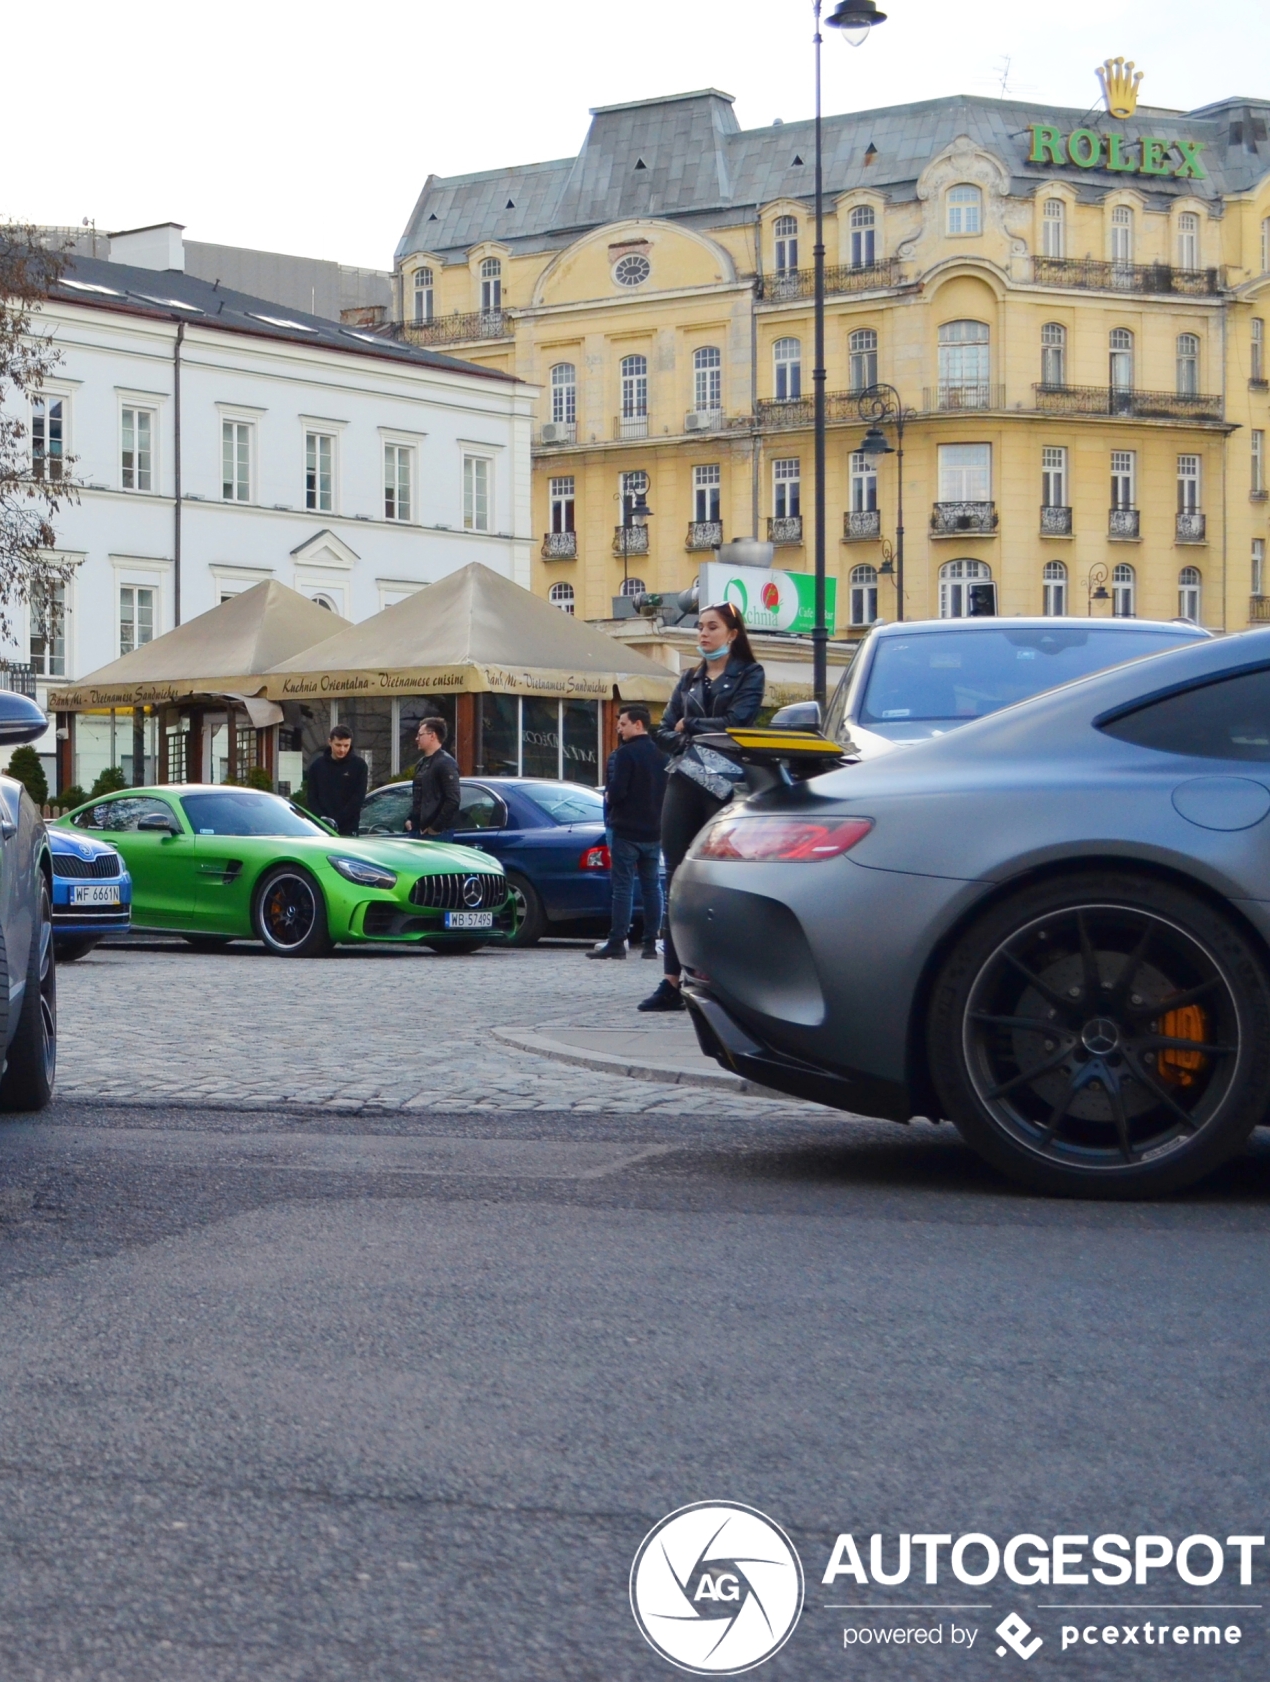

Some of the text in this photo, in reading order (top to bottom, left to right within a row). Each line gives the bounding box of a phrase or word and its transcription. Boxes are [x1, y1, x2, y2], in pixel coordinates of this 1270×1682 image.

[1028, 124, 1207, 180] ROLEX
[282, 678, 318, 693] Kuchnia
[320, 675, 369, 692] Orientalna
[378, 672, 430, 688] Vietnamese
[432, 673, 464, 687] cuisine
[523, 673, 566, 691] Vietnamese
[566, 676, 608, 694] Sandwiches
[90, 690, 133, 704] Vietnamese
[133, 685, 179, 703] Sandwiches
[76, 886, 119, 901] WF 6661N
[451, 913, 491, 926] WB 5749S
